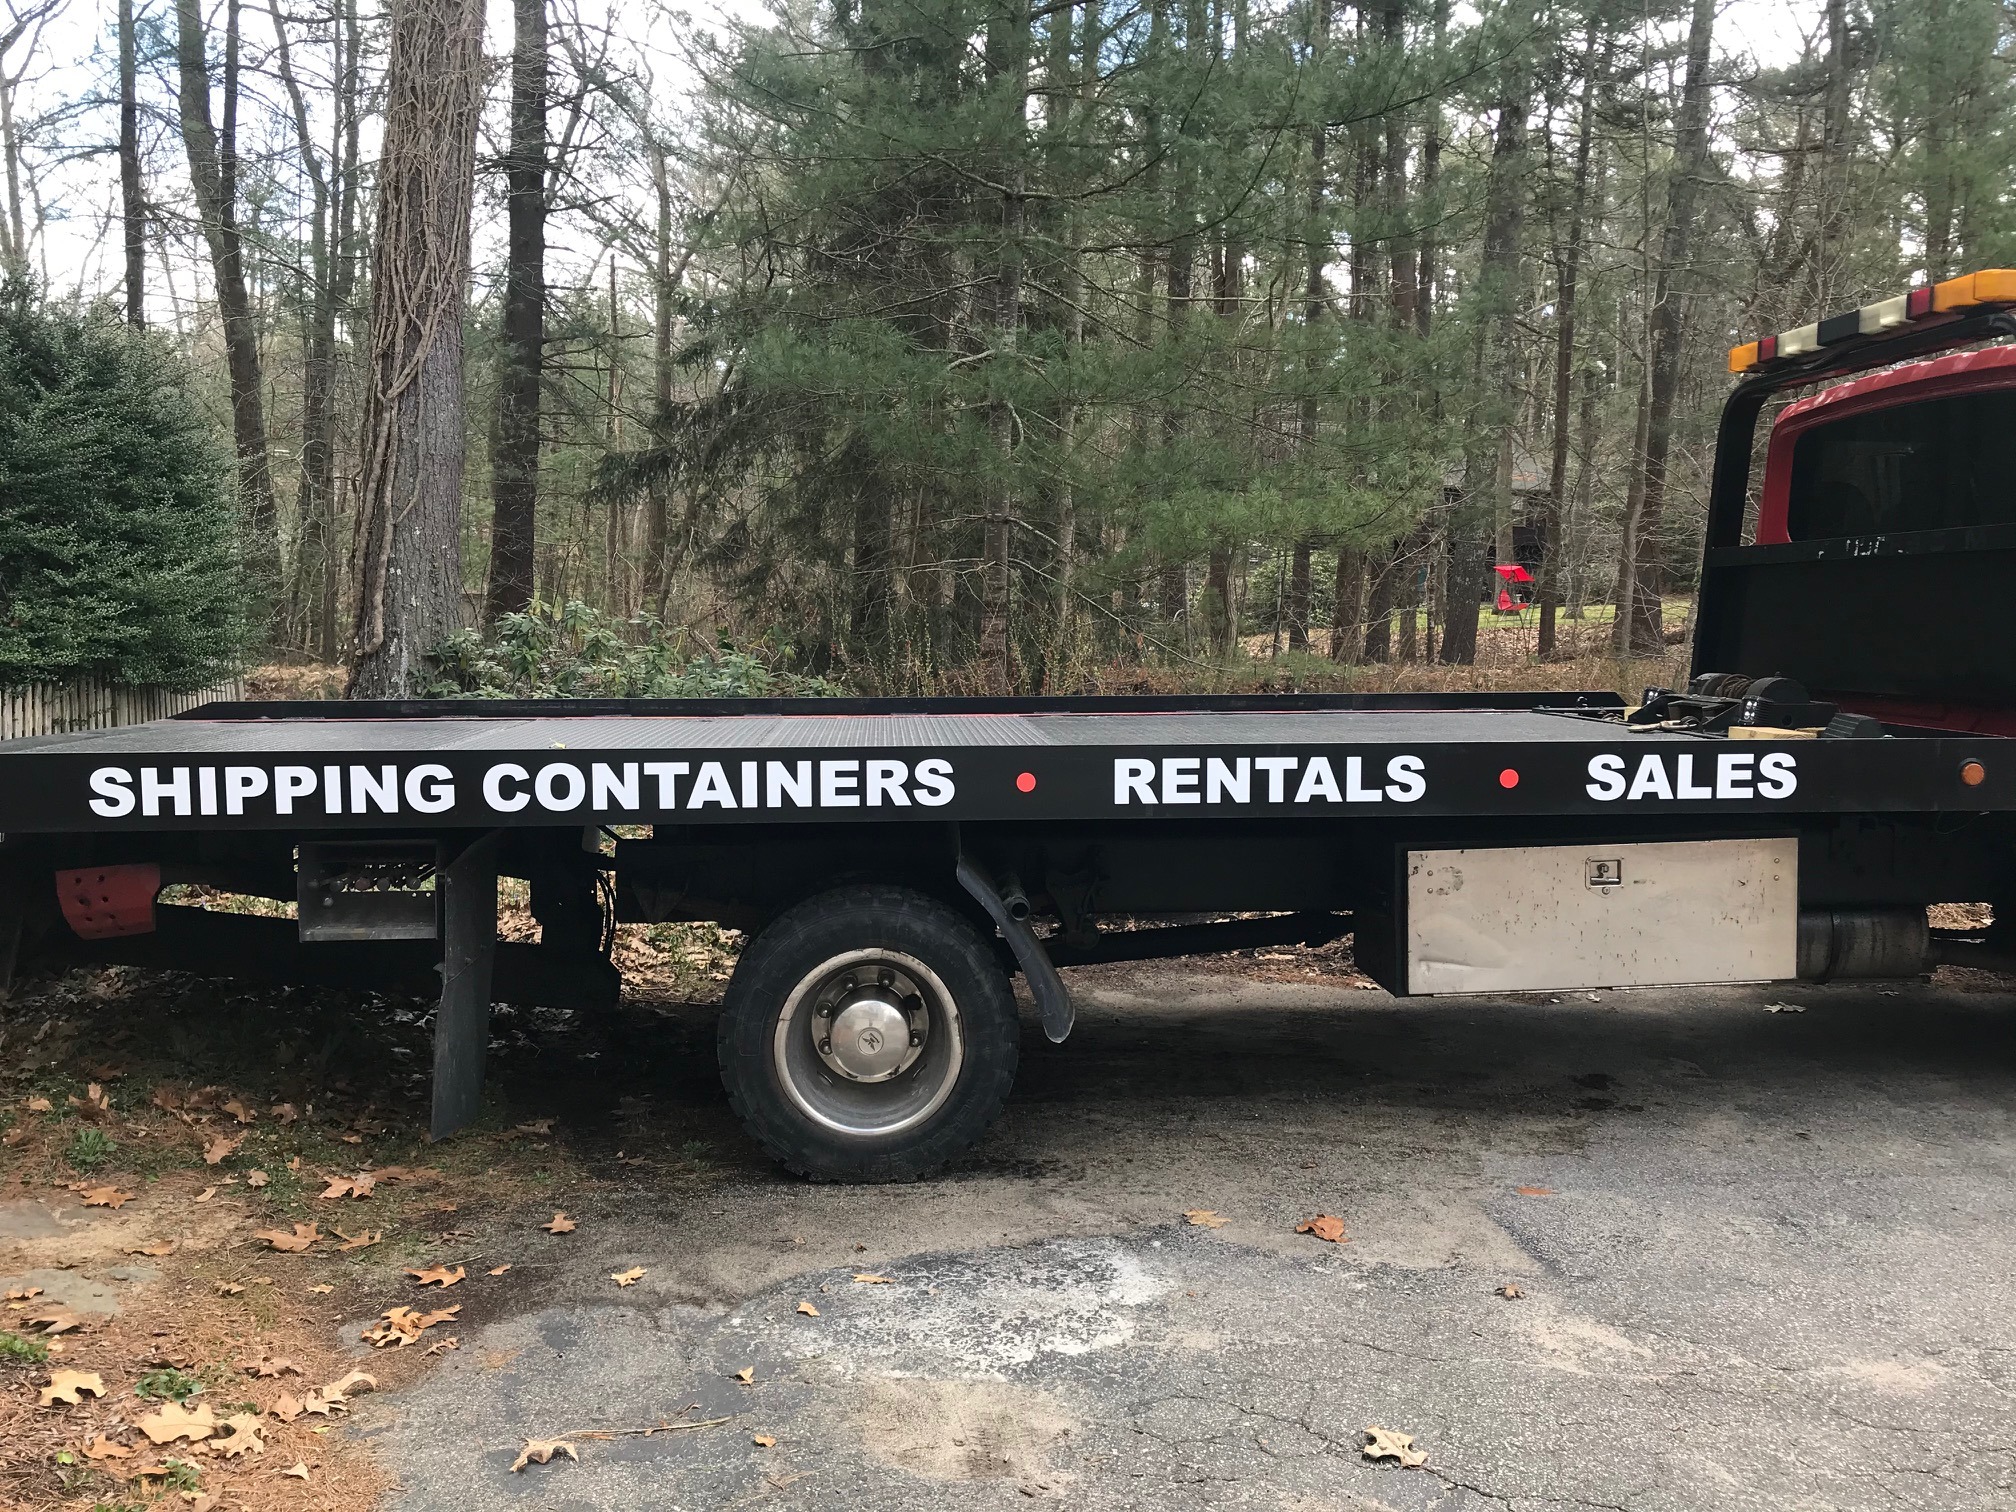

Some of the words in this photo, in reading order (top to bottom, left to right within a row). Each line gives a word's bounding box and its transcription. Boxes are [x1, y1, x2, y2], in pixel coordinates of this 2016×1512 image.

[88, 762, 456, 818] SHIPPING
[482, 757, 956, 813] CONTAINERS
[1114, 754, 1427, 805] RENTALS
[1585, 752, 1798, 801] SALES
